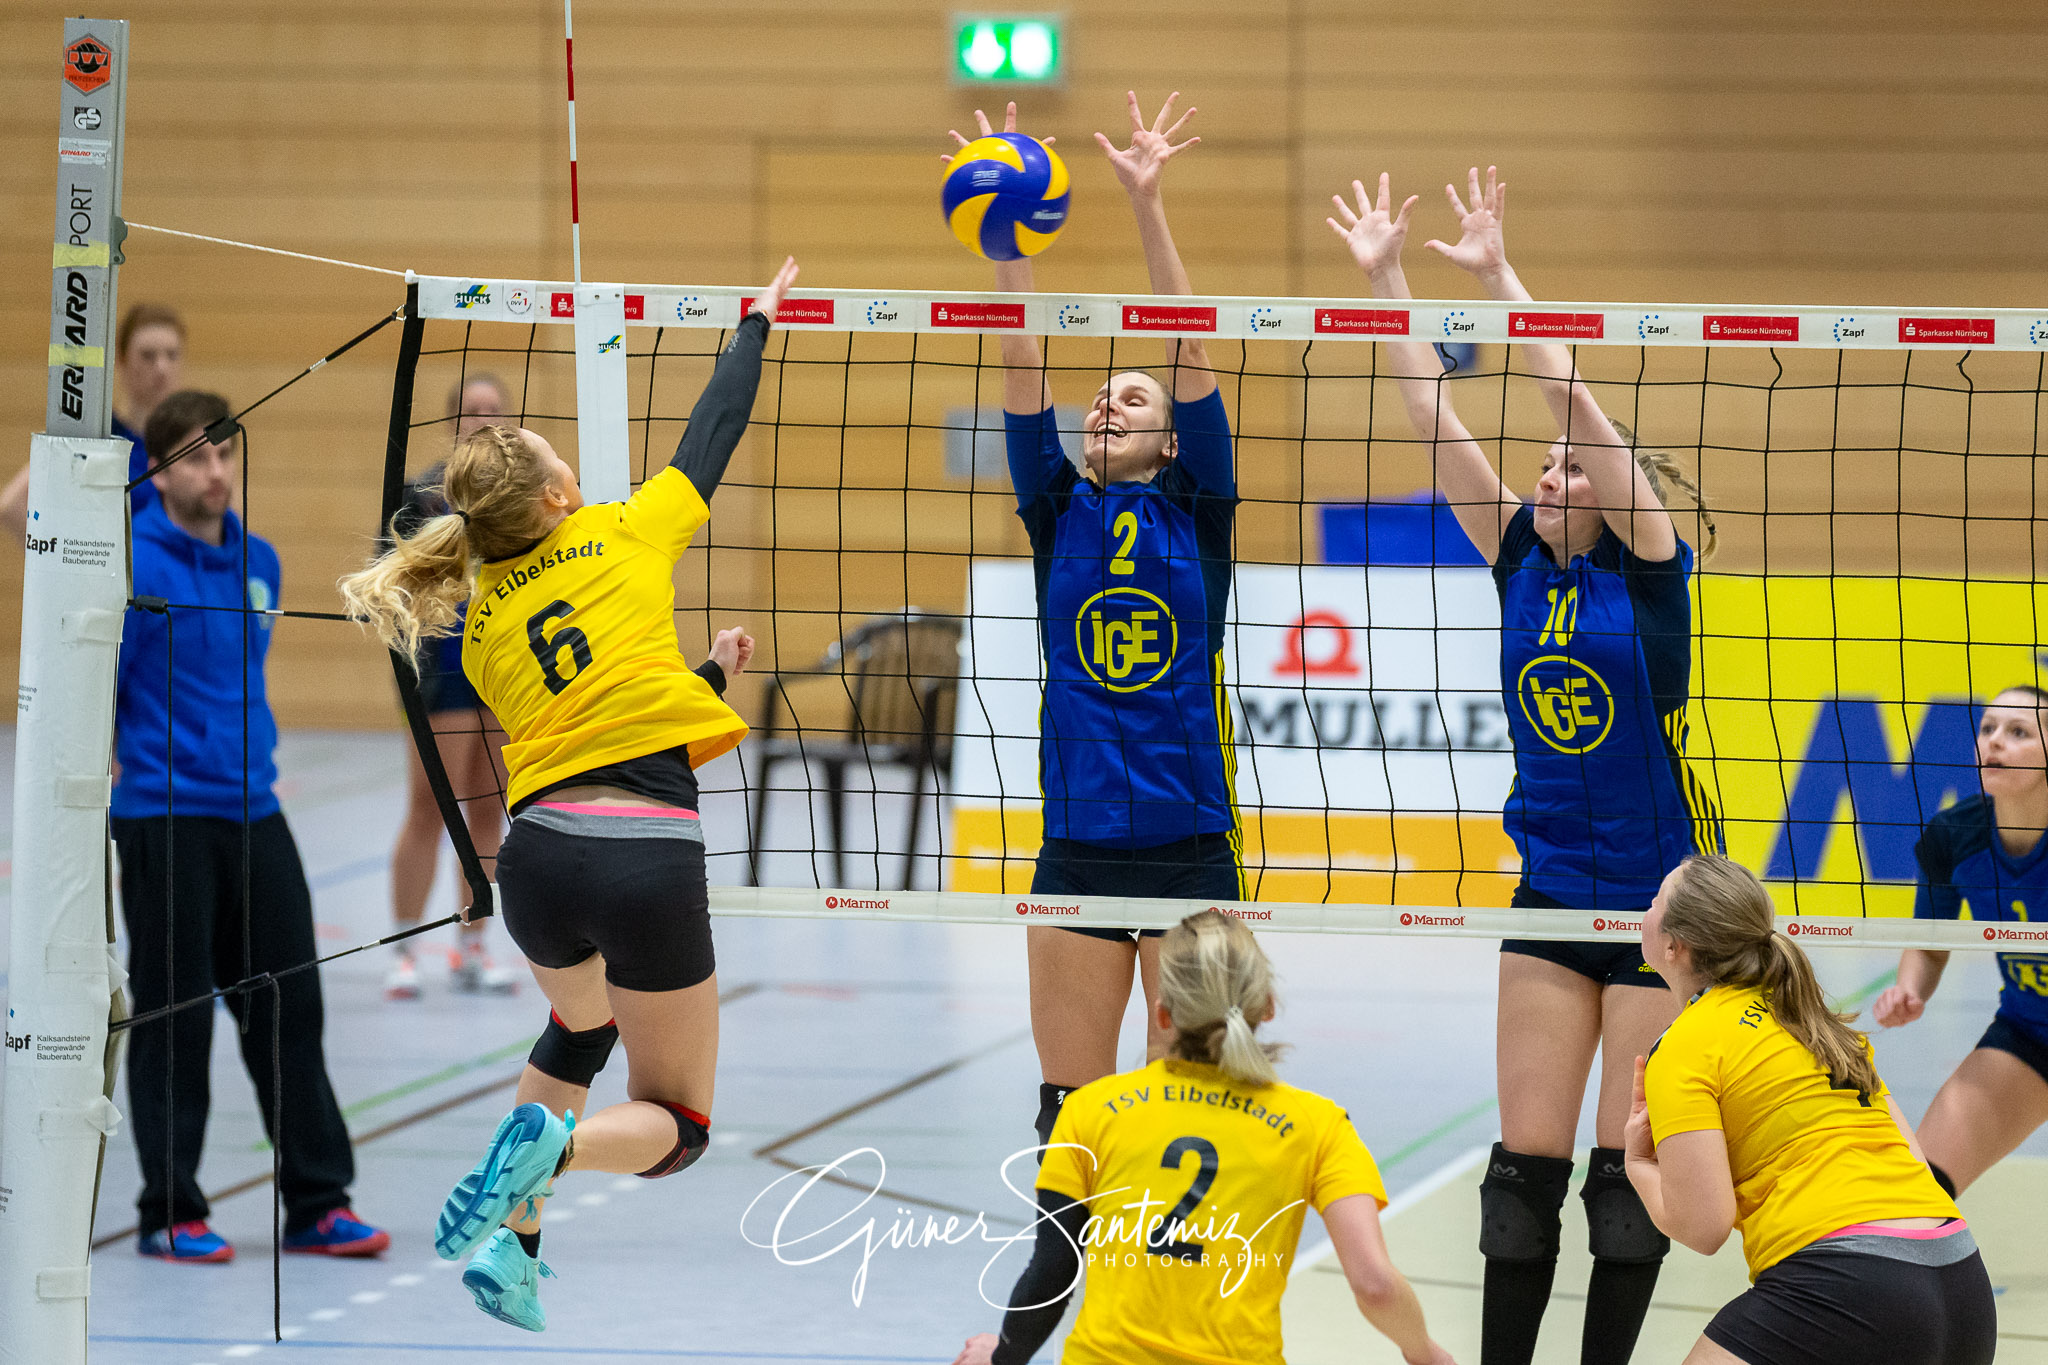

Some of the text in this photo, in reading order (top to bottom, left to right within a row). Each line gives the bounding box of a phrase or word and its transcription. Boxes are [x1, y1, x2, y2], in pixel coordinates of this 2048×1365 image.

[62, 183, 93, 421] ERARD PORT
[454, 292, 490, 305] HUCK
[685, 307, 708, 318] Zapf
[795, 309, 827, 319] Nürnberg
[875, 311, 898, 323] Zapf
[950, 313, 1019, 323] Sparkasse Nürnberg
[1067, 315, 1090, 325] Zapf
[1142, 316, 1210, 327] Sparkasse Nürnberg
[1259, 319, 1282, 329] Zapf
[1334, 319, 1403, 330] Sparkasse Nürnberg
[1452, 322, 1475, 332] Zapf
[1528, 323, 1598, 333] Sparkasse Nürnberg
[1647, 325, 1670, 335] Zapf
[1723, 326, 1792, 337] Sparkasse Nürnberg
[1842, 328, 1865, 338] Zapf
[1918, 328, 1988, 339] Sparkasse Nürnberg
[63, 538, 115, 548] Kalksandsteine
[1109, 511, 1138, 575] 2
[62, 547, 110, 557] Energiewände
[62, 556, 106, 567] Bauberatung
[470, 540, 605, 646] TSV Eibelstadt
[1538, 586, 1578, 647] 10
[526, 599, 594, 697] 6
[840, 897, 890, 910] Marmot
[1030, 903, 1080, 916] Marmot
[1222, 908, 1272, 921] Marmot
[1414, 914, 1465, 926] Marmot
[1802, 924, 1853, 937] Marmot
[1997, 929, 2048, 941] Marmot
[1738, 1000, 1769, 1030] TSV
[36, 1034, 91, 1043] Kalksandsteine
[36, 1043, 86, 1053] Energiewände
[36, 1052, 82, 1062] Bauberatung
[1103, 1085, 1295, 1138] TSV Eibelstadt
[1146, 1135, 1220, 1263] 2
